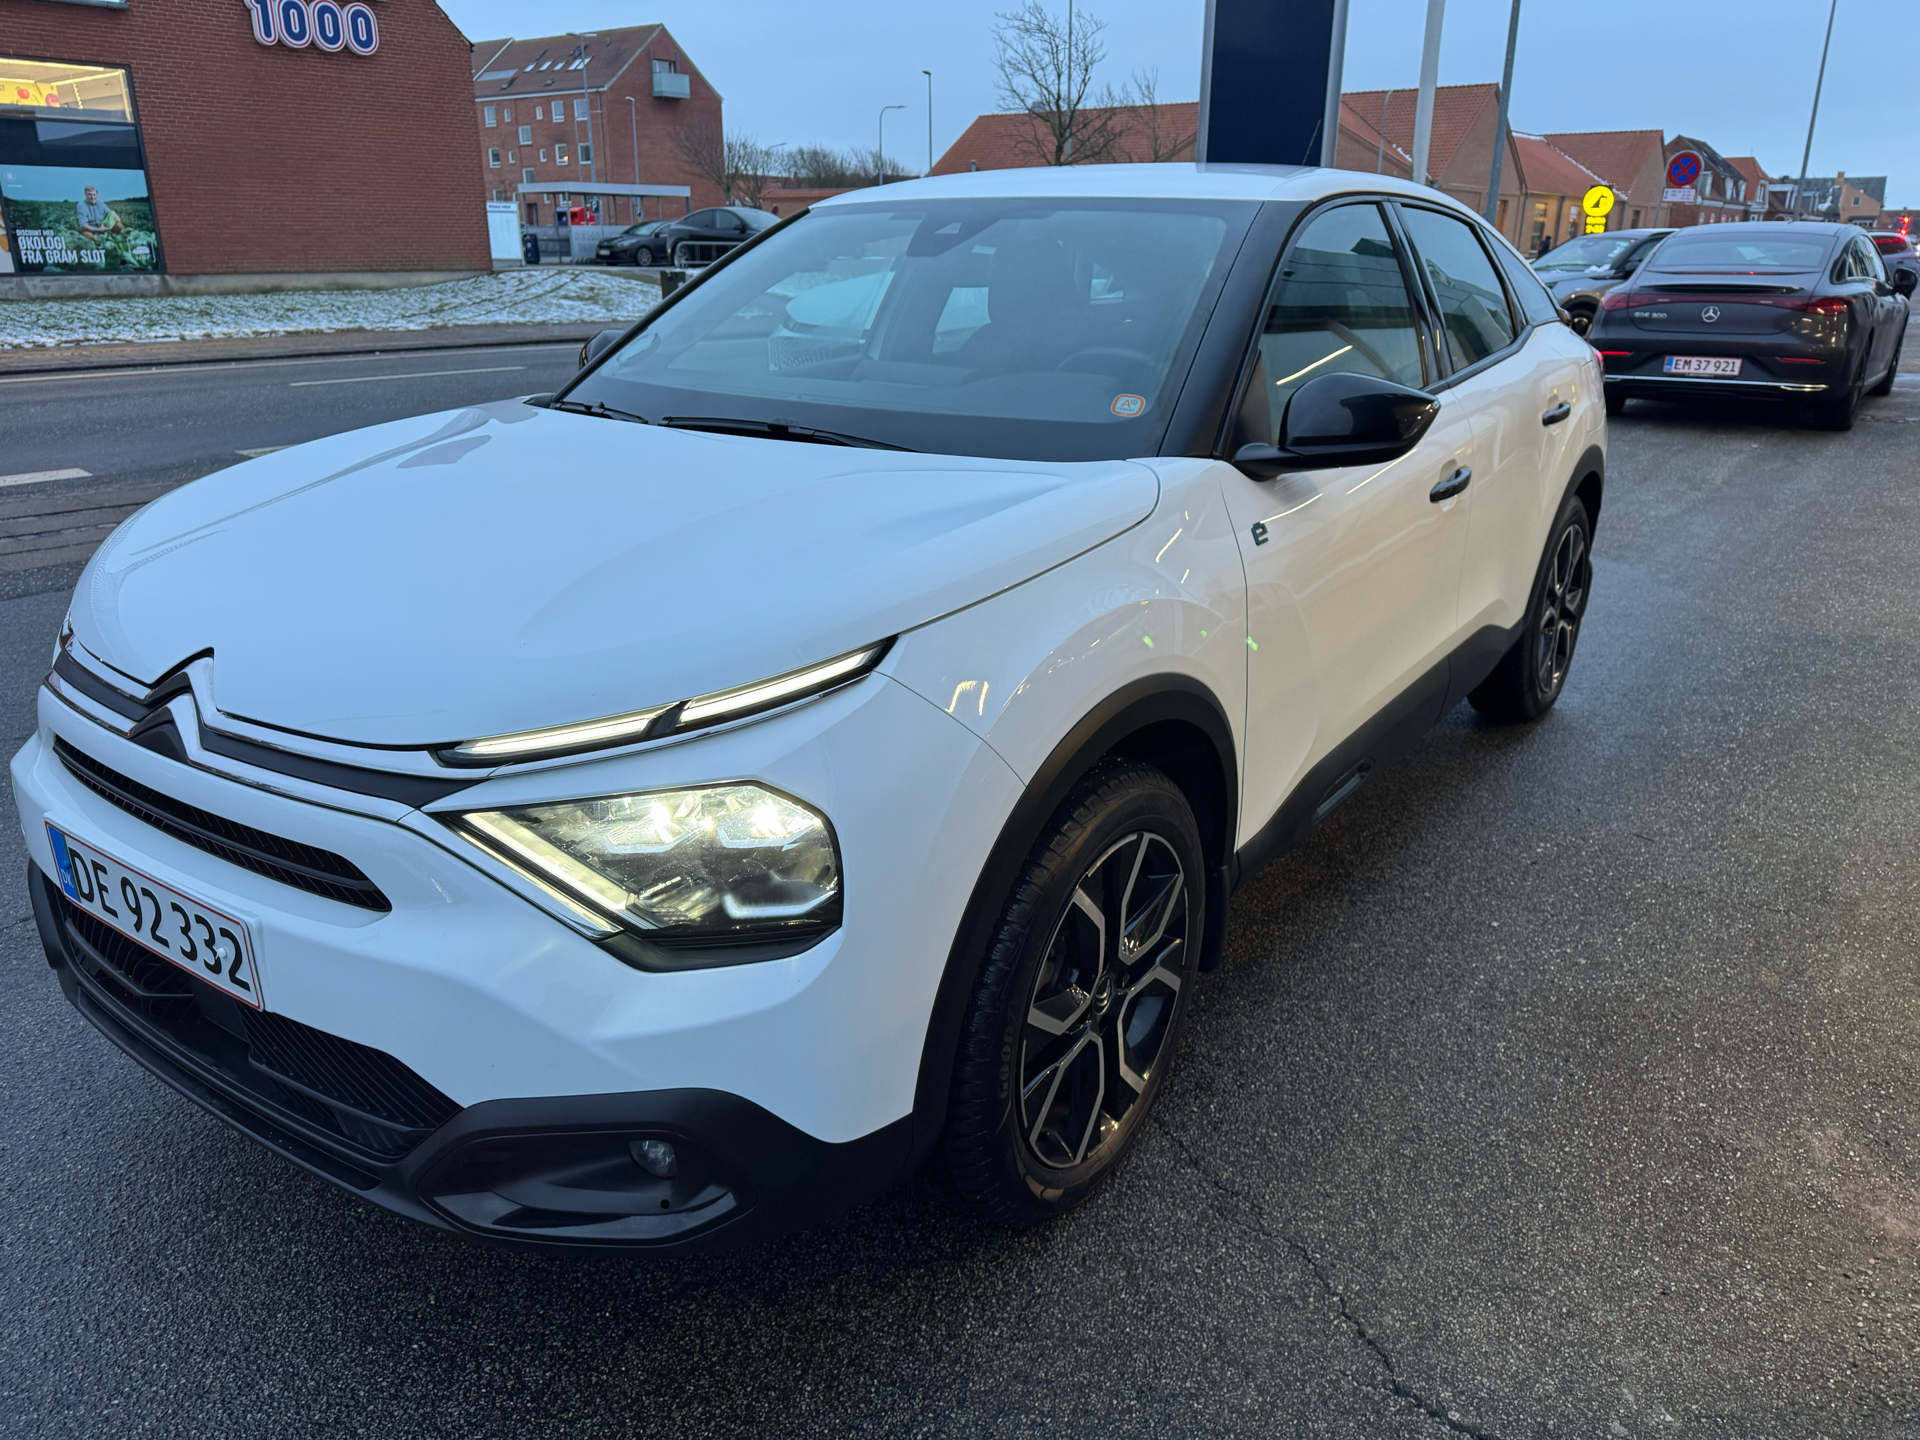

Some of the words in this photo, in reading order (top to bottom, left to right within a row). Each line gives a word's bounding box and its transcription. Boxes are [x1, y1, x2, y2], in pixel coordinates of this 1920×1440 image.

[244, 0, 379, 55] 1000
[18, 236, 66, 250] ØKOLOGI
[21, 250, 44, 264] FRA
[45, 250, 78, 264] GRAM
[81, 250, 106, 264] SLOT
[1674, 359, 1692, 371] EM
[1694, 360, 1711, 371] 37
[1714, 360, 1736, 372] 921
[61, 868, 74, 888] DK
[68, 846, 118, 919] DE
[120, 876, 170, 949] 92
[170, 901, 251, 992] 332
